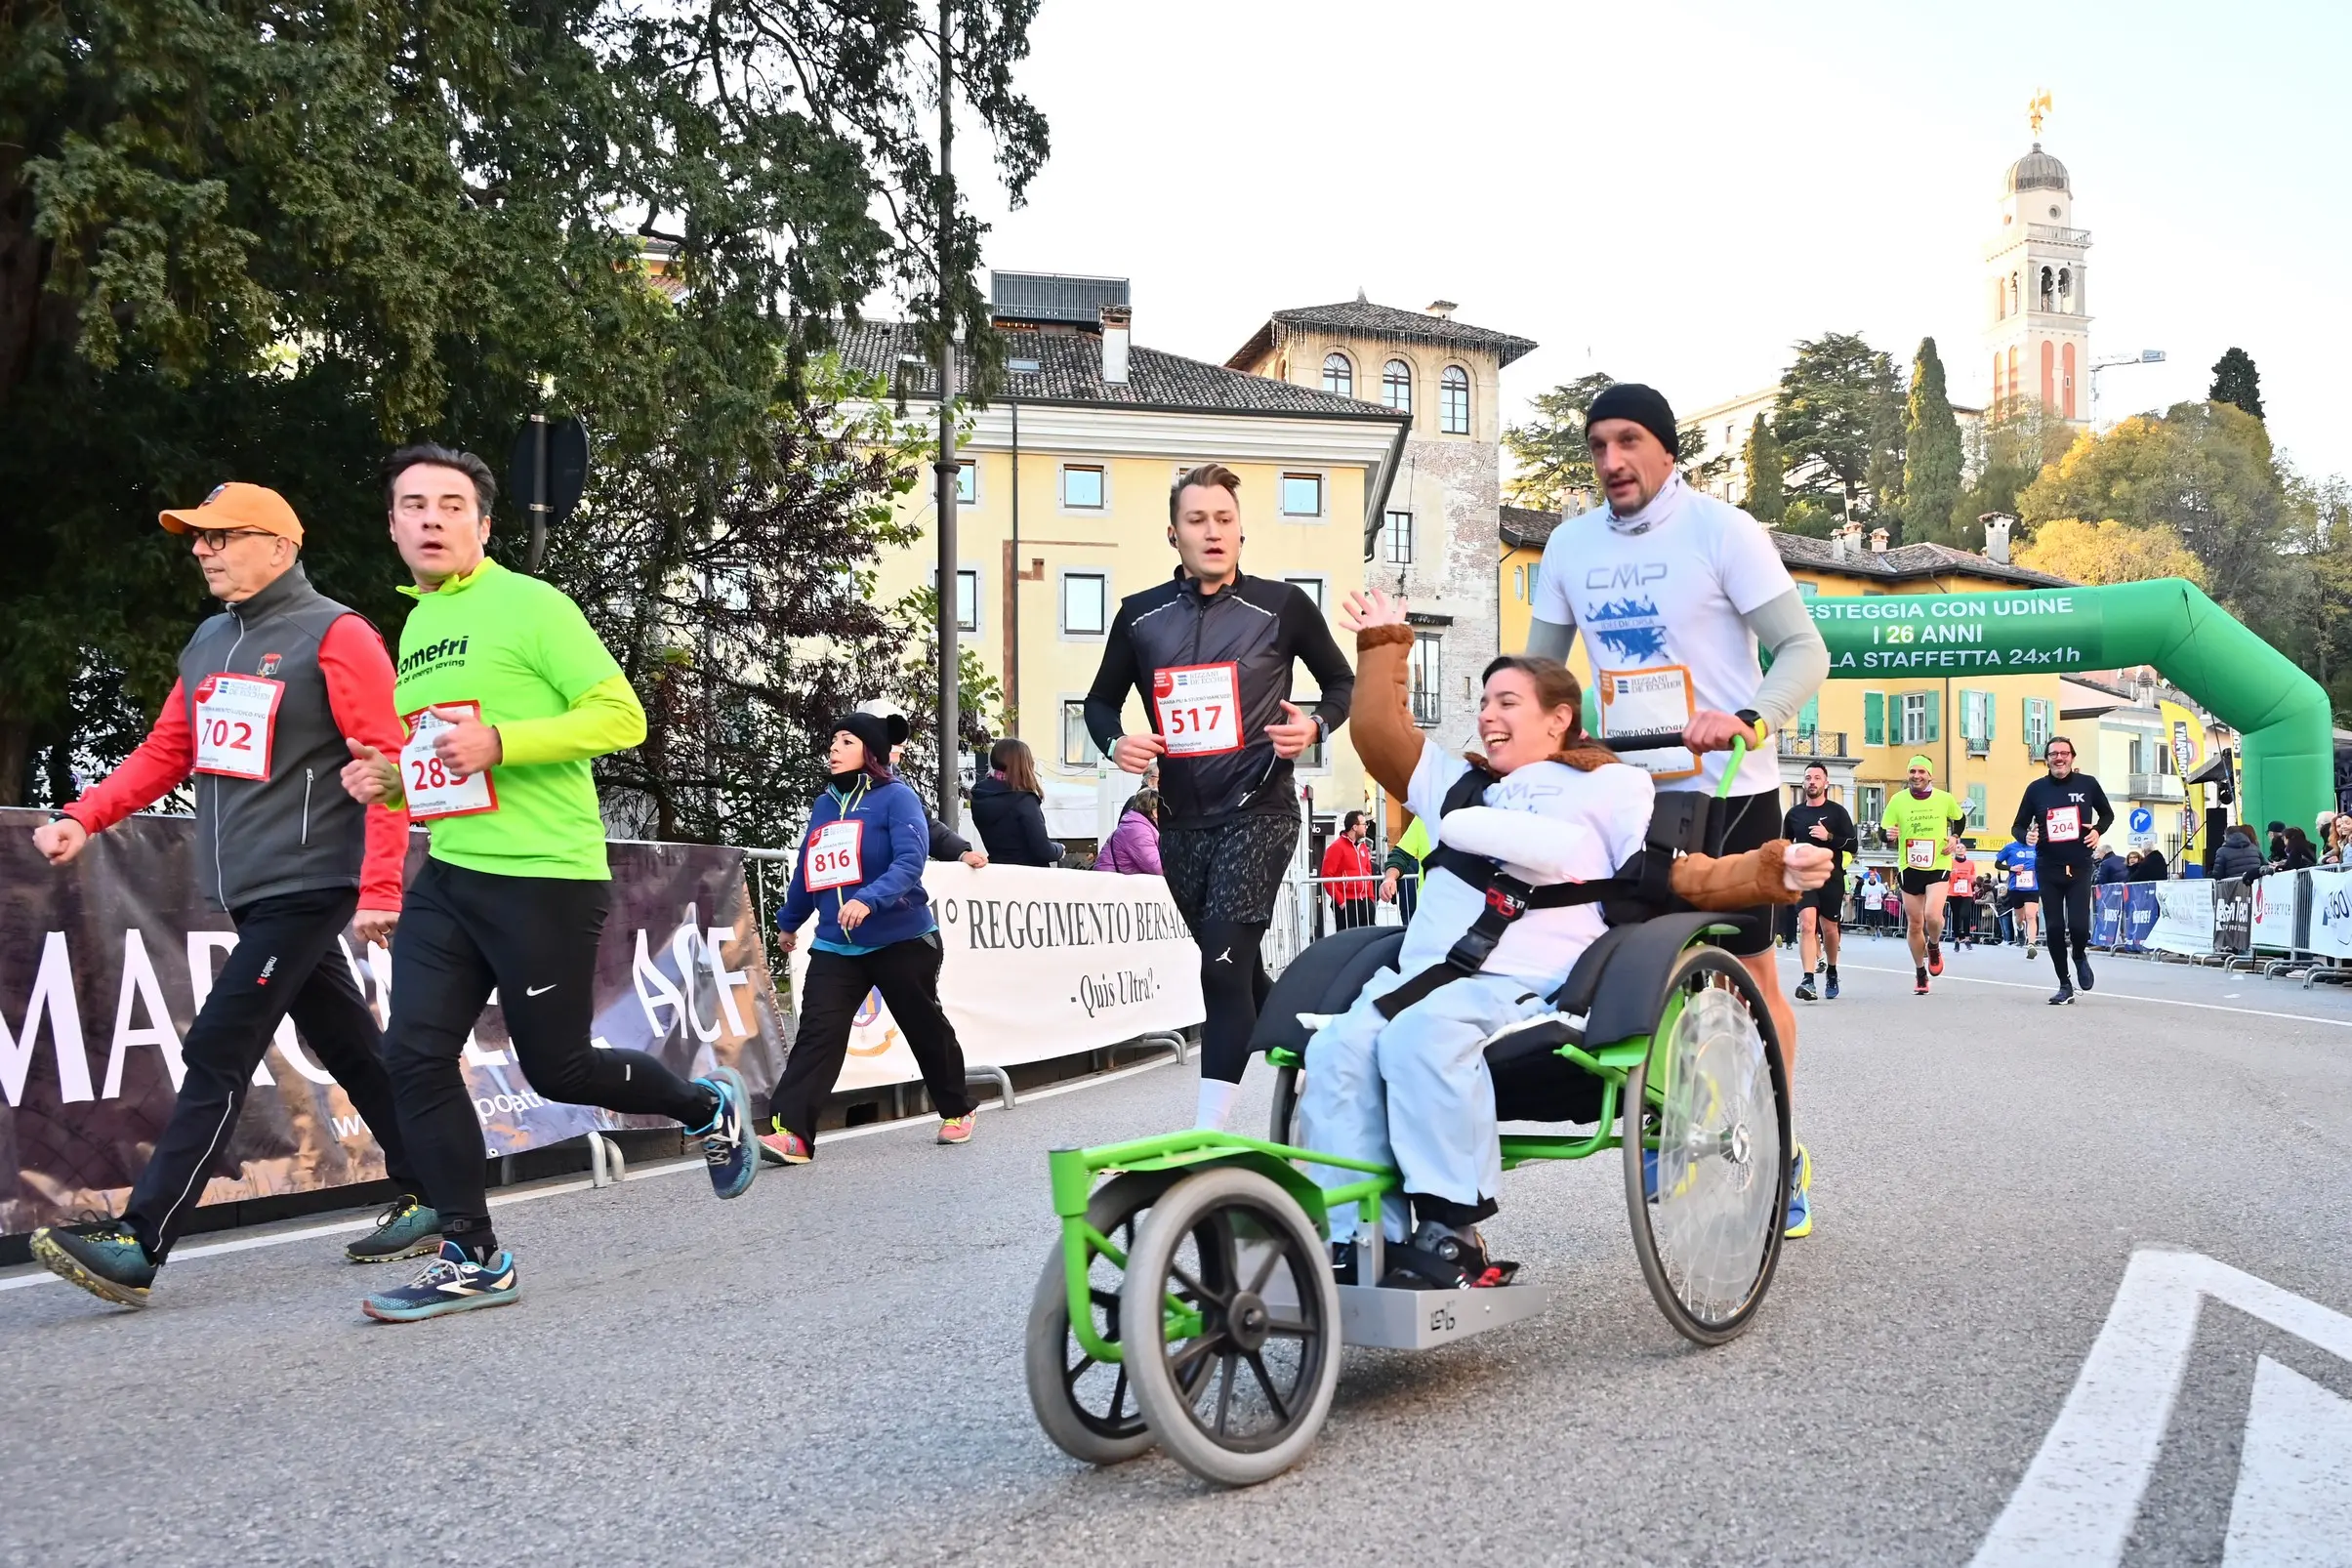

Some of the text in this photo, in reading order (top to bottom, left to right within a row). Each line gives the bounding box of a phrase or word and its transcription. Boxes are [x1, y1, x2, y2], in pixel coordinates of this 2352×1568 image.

[1586, 563, 1668, 590] CMP
[1805, 597, 2074, 620] ESTEGGIA CON UDINE
[1873, 624, 1983, 644] I 26 ANNI
[398, 636, 469, 676] omefri
[434, 659, 465, 670] saving
[1863, 648, 2002, 668] STAFFETTA
[2008, 646, 2081, 665] 24x1h
[1172, 705, 1222, 734] 517
[202, 718, 252, 751] 702
[2067, 792, 2085, 803] TK
[2051, 822, 2074, 834] 204
[814, 848, 850, 873] 816
[1911, 853, 1929, 863] 504
[966, 898, 1131, 949] REGGIMENTO
[632, 923, 749, 1043] ACF
[1080, 972, 1116, 1018] Quis
[1116, 967, 1154, 1006] Ultra?
